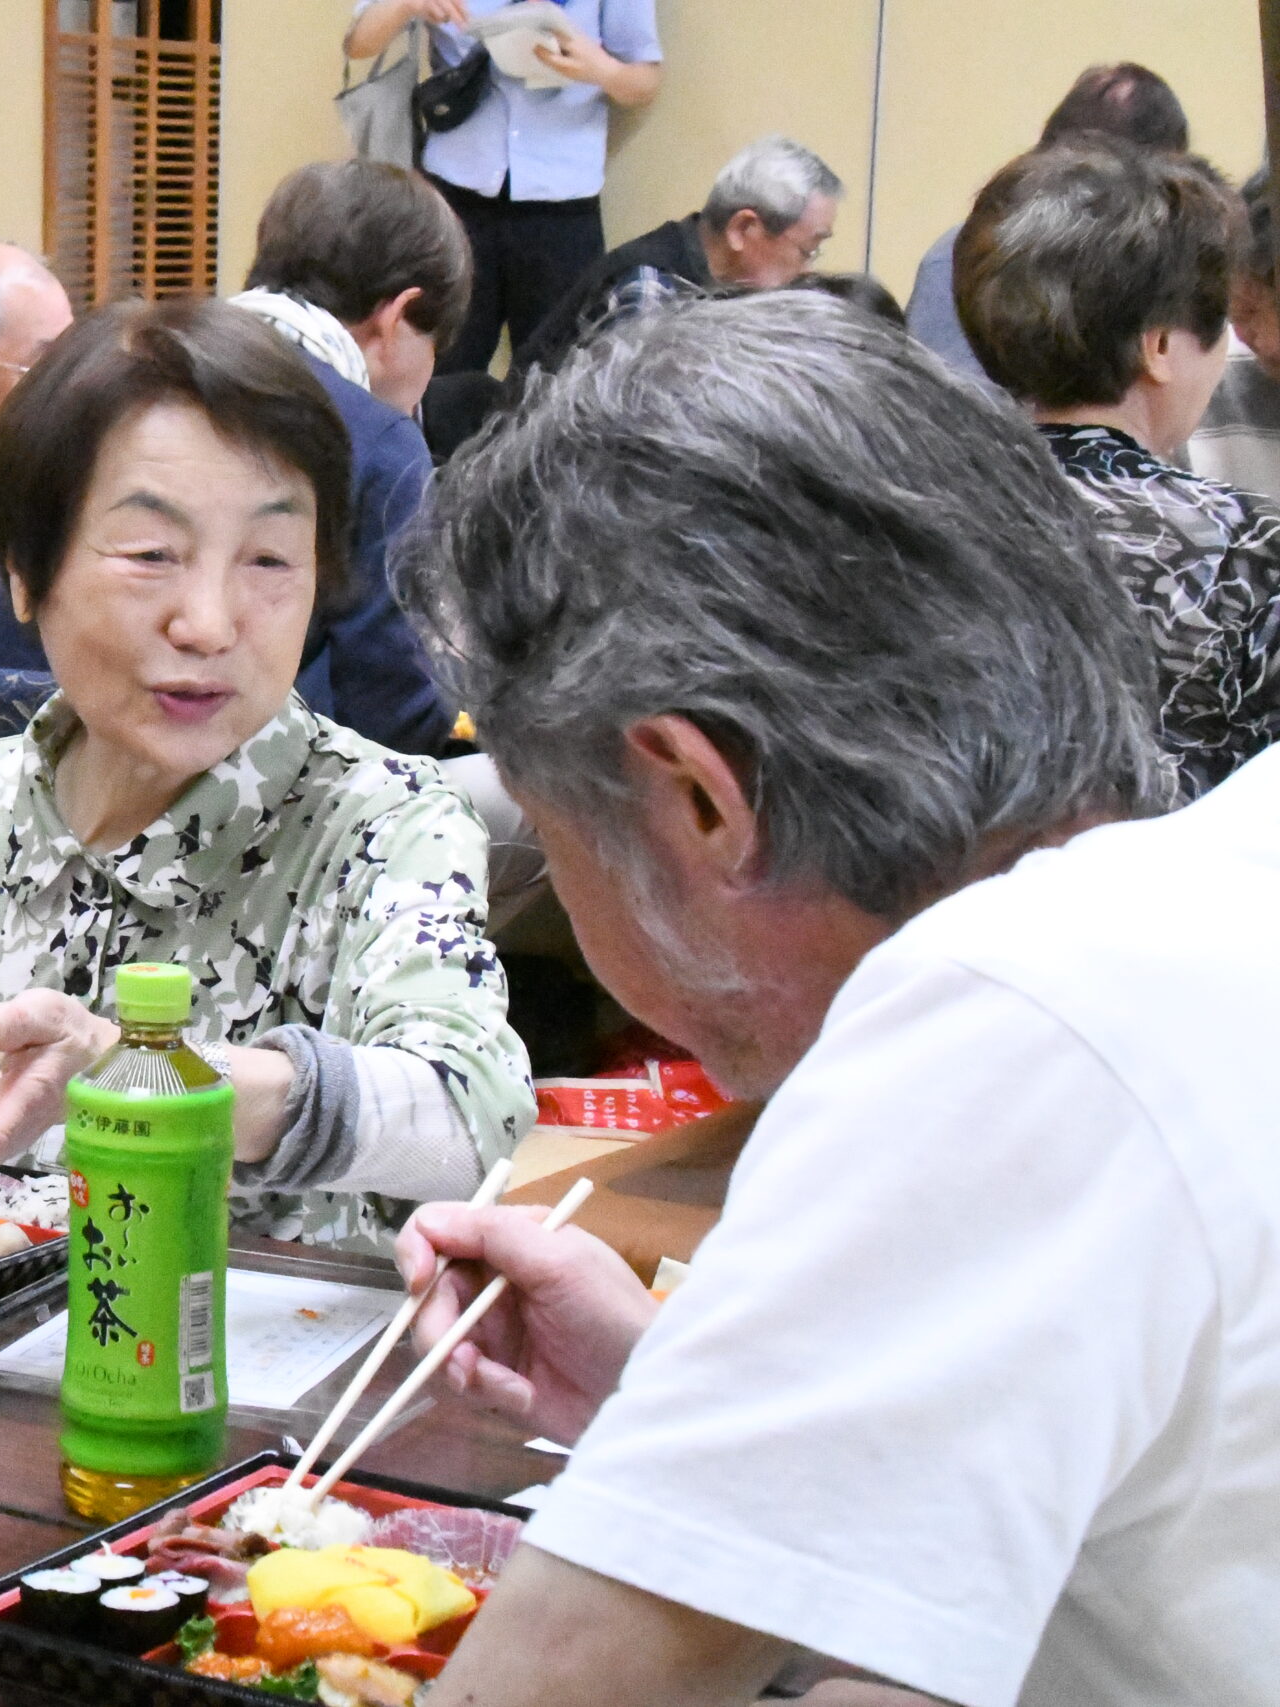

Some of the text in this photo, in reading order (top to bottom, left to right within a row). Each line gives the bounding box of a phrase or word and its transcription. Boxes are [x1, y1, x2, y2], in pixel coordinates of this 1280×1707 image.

[95, 1114, 152, 1138] 伊藤園
[81, 1215, 139, 1347] お茶
